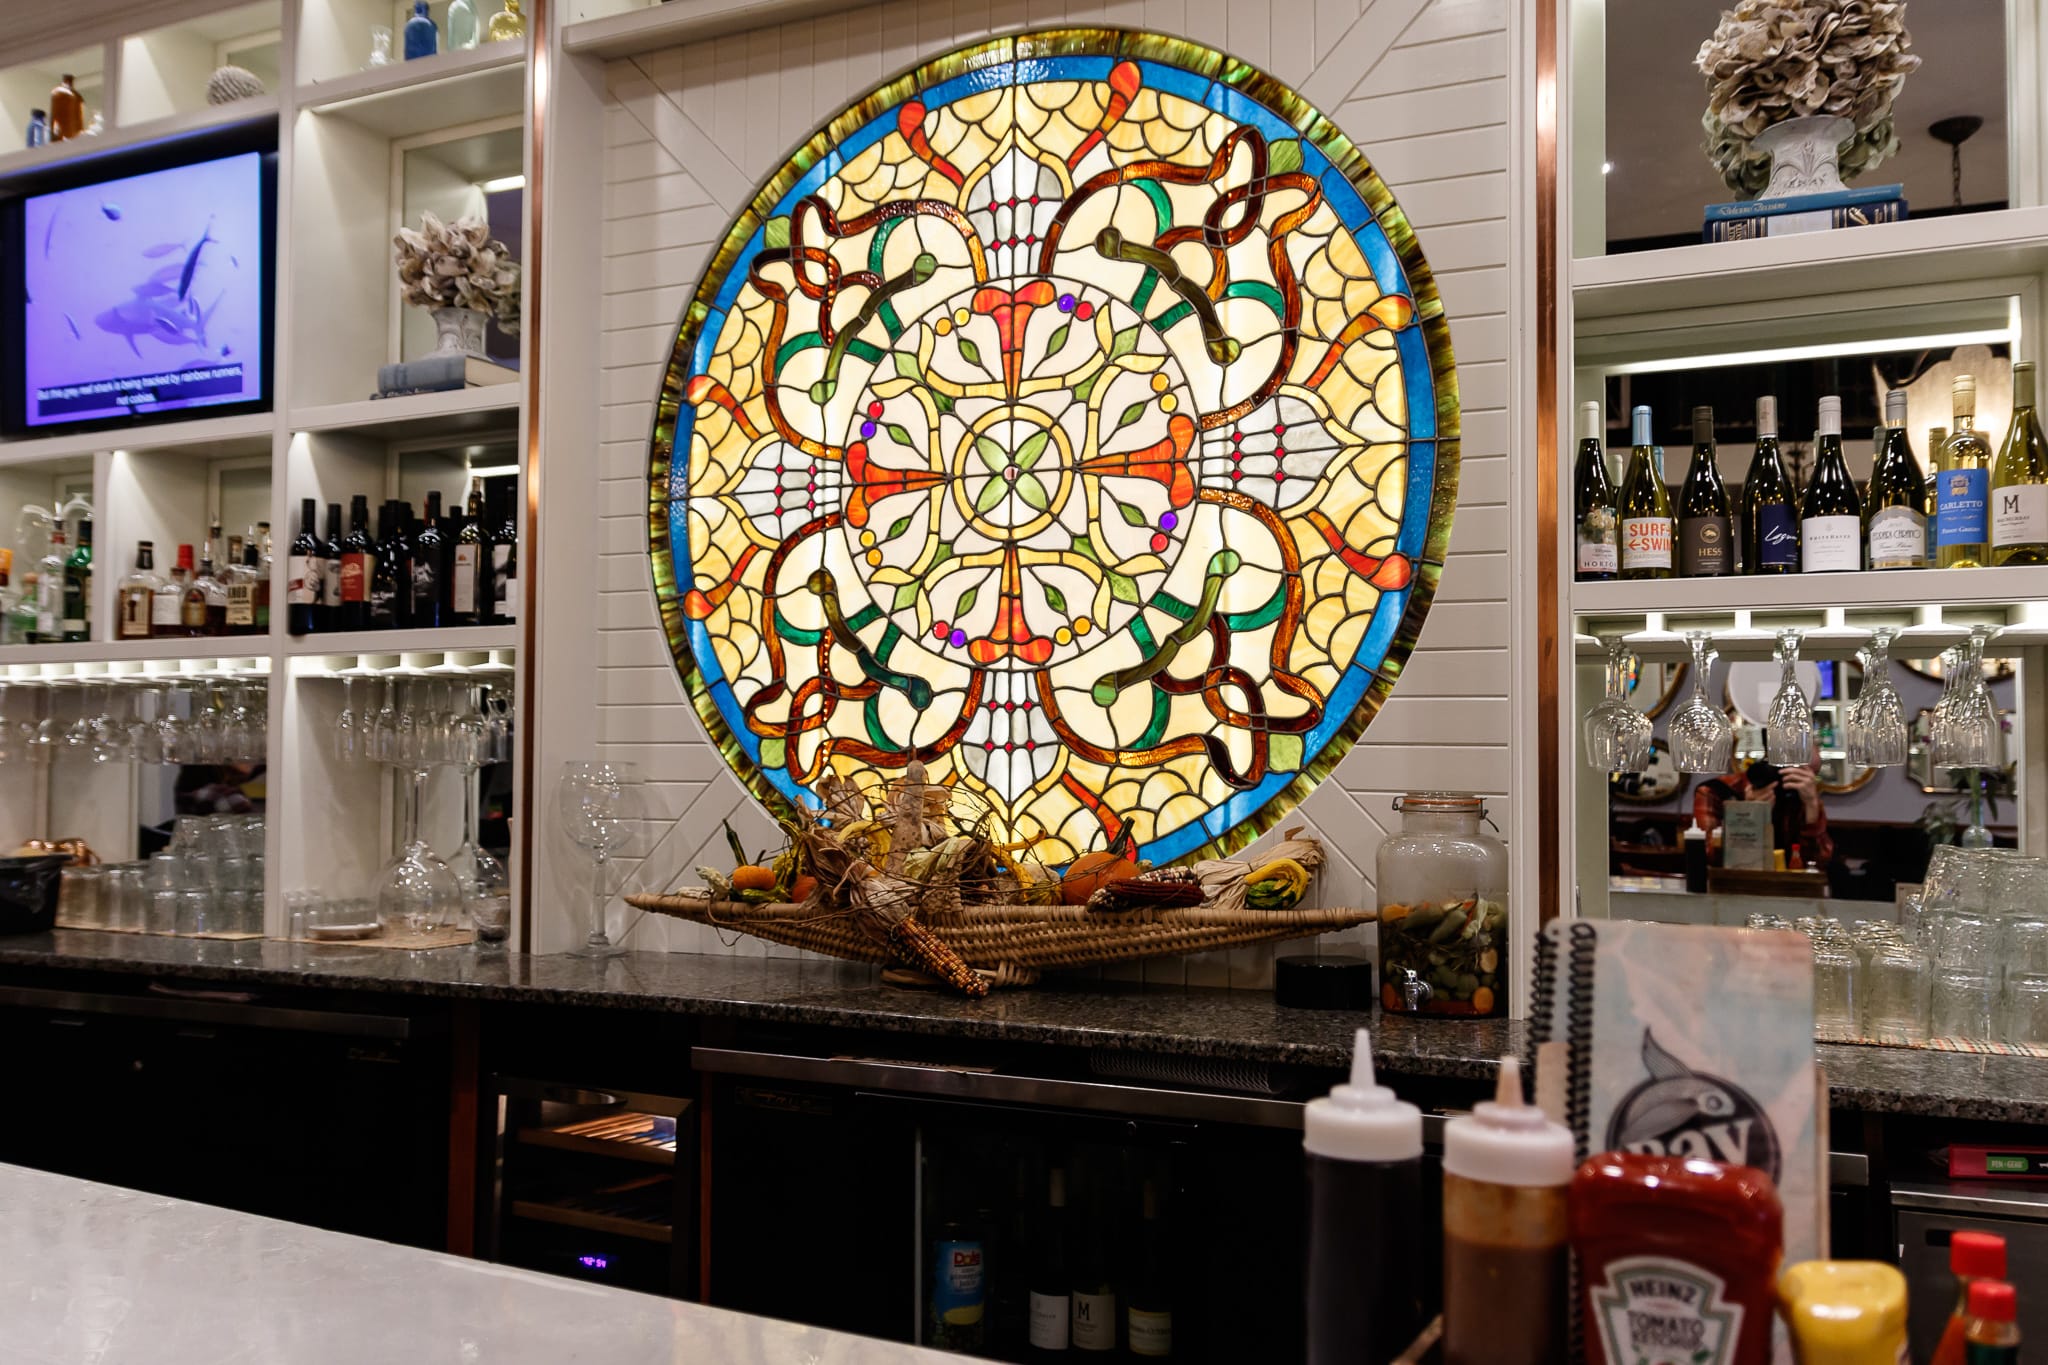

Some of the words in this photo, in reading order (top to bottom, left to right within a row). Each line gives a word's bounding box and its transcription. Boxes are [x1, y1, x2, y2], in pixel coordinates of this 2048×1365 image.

[1940, 500, 1983, 511] CARLETTO
[2003, 494, 2020, 515] M
[1630, 522, 1666, 537] SURF
[1698, 547, 1723, 557] HESS
[954, 1251, 981, 1266] Dole
[1629, 1279, 1698, 1304] HEINZ
[1627, 1310, 1706, 1338] TOMATO
